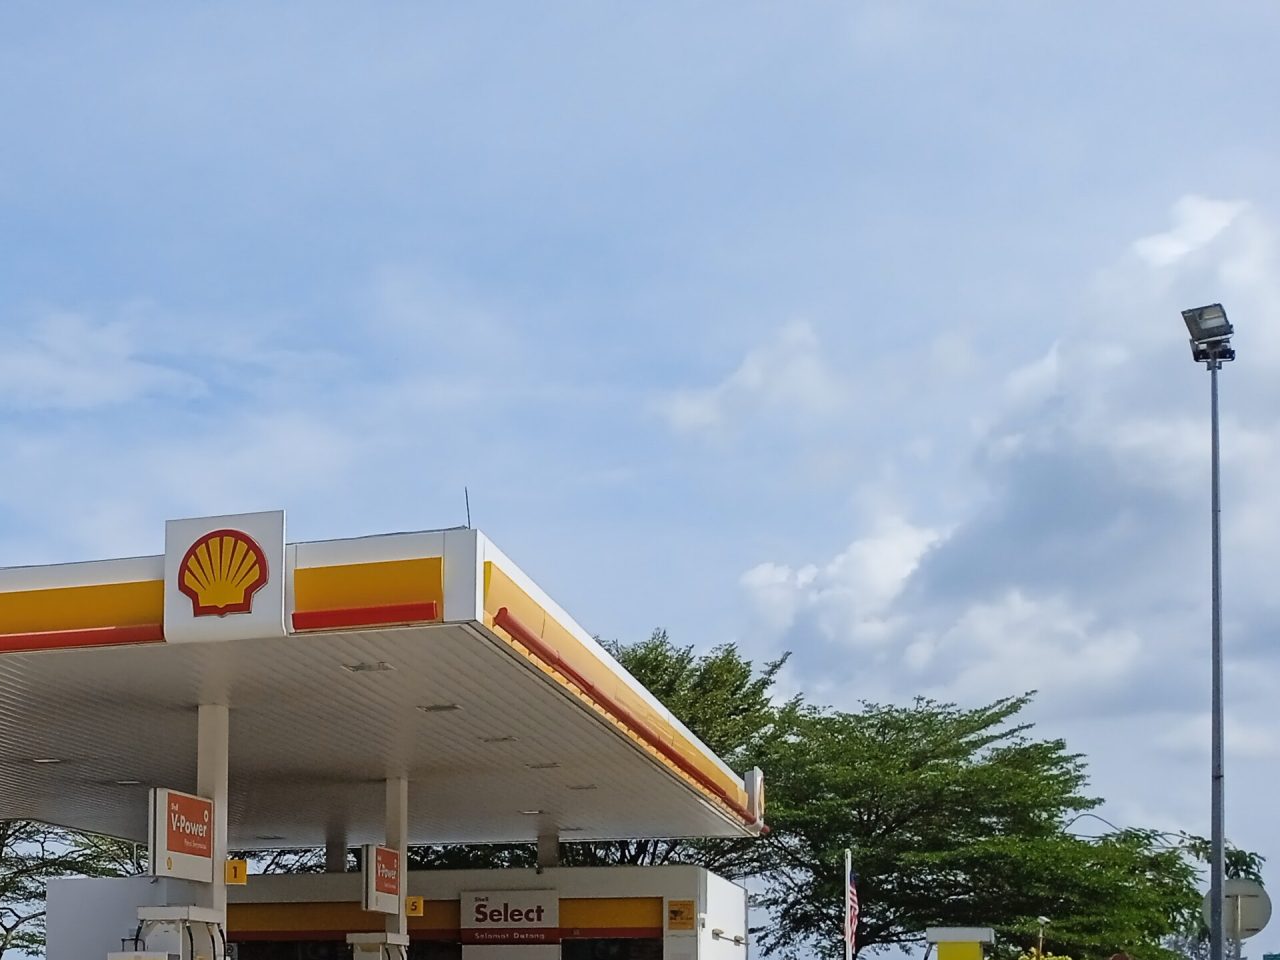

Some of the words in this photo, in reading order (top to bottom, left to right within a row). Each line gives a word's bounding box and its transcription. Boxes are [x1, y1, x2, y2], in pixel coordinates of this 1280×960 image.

[171, 812, 208, 838] V-Power
[231, 865, 238, 879] 1
[410, 901, 418, 911] 5
[474, 902, 545, 923] Select
